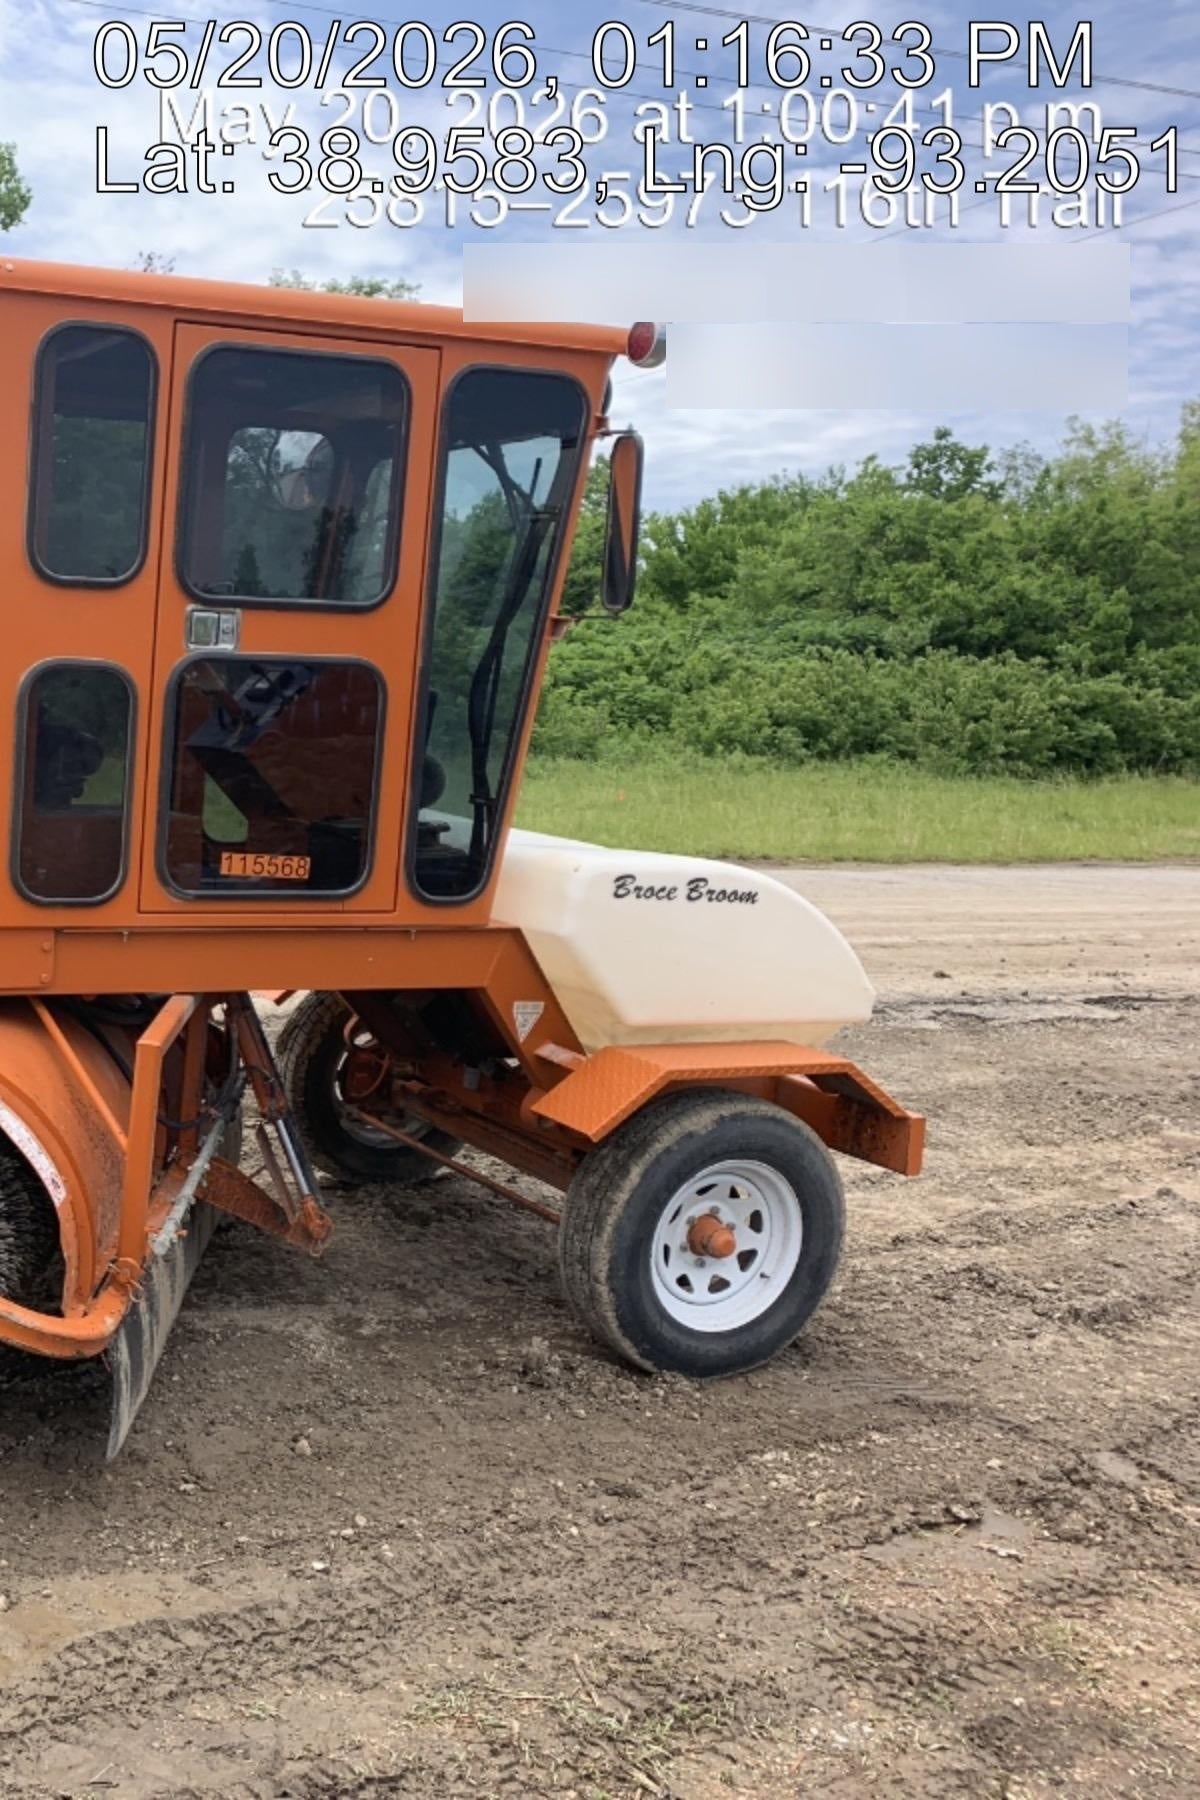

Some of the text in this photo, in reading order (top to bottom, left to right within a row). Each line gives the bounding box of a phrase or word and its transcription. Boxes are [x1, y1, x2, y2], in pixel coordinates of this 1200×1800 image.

[224, 854, 309, 877] 115568
[612, 874, 760, 905] Broce Broom
